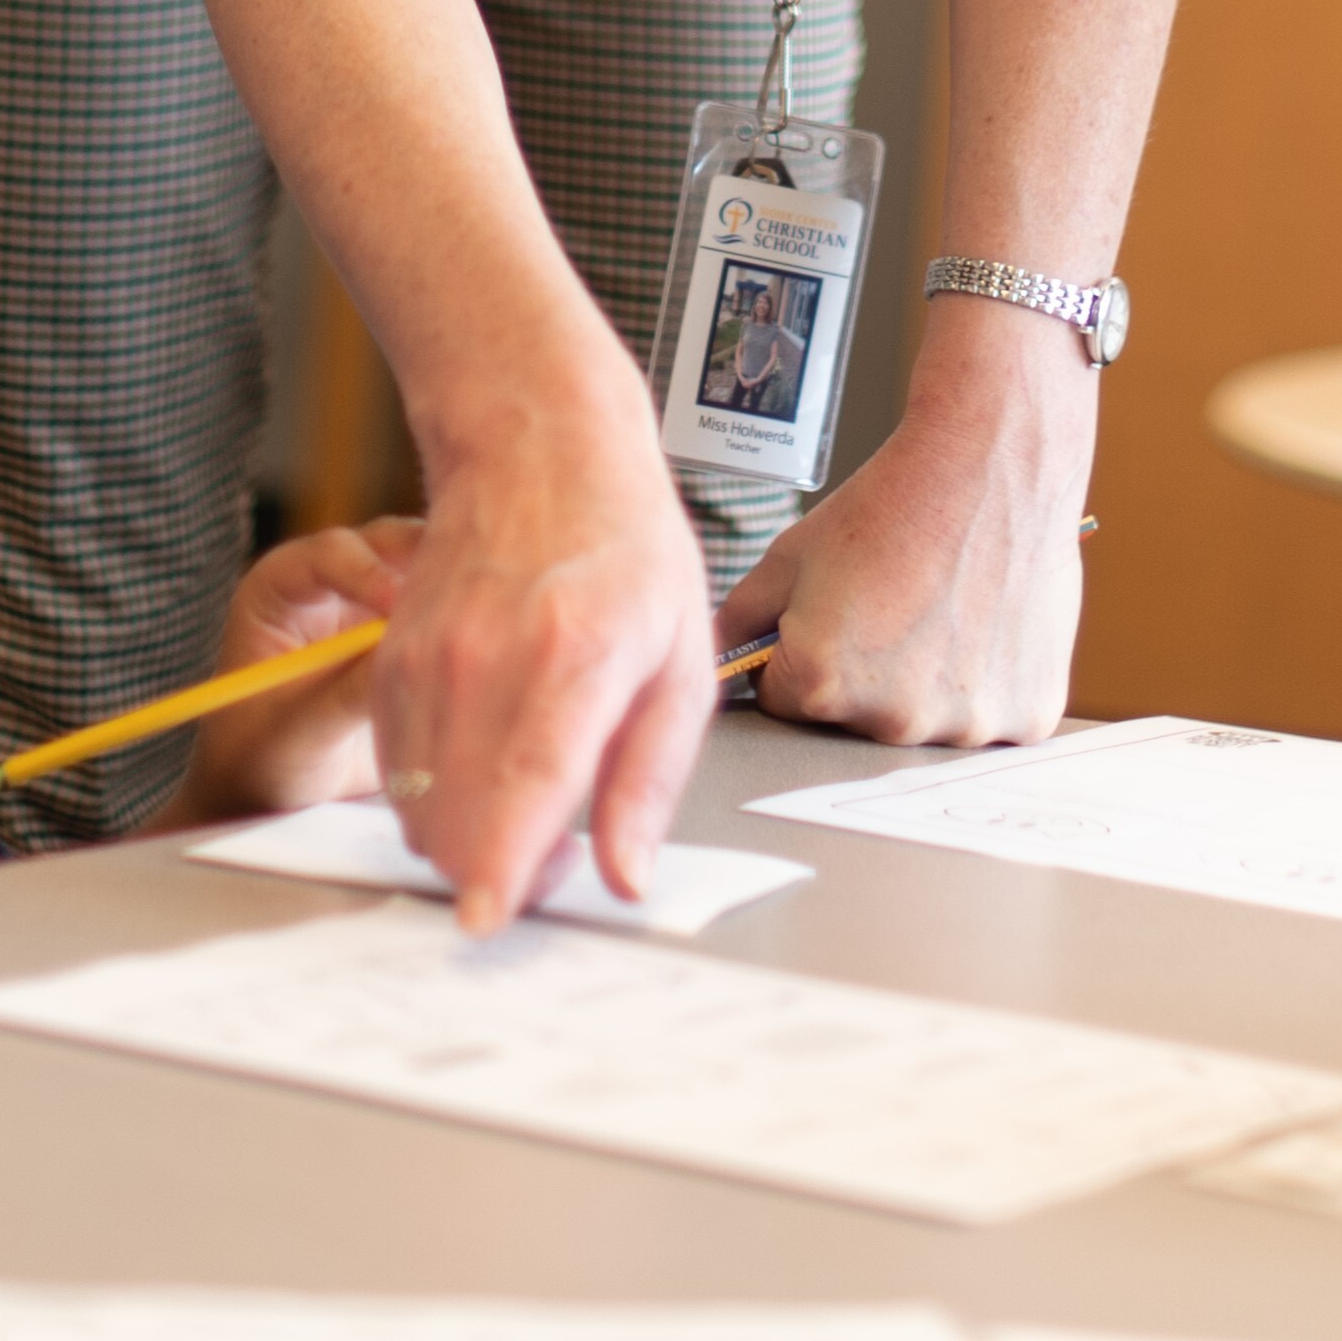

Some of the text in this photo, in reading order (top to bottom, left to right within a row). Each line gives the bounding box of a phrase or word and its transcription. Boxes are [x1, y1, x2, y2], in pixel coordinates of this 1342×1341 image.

[753, 233, 819, 259] SCHOOL
[756, 218, 847, 248] CHRISTIAN
[698, 414, 794, 445] Miss Holwerda
[725, 438, 761, 453] Teacher
[728, 640, 759, 659] EASY!
